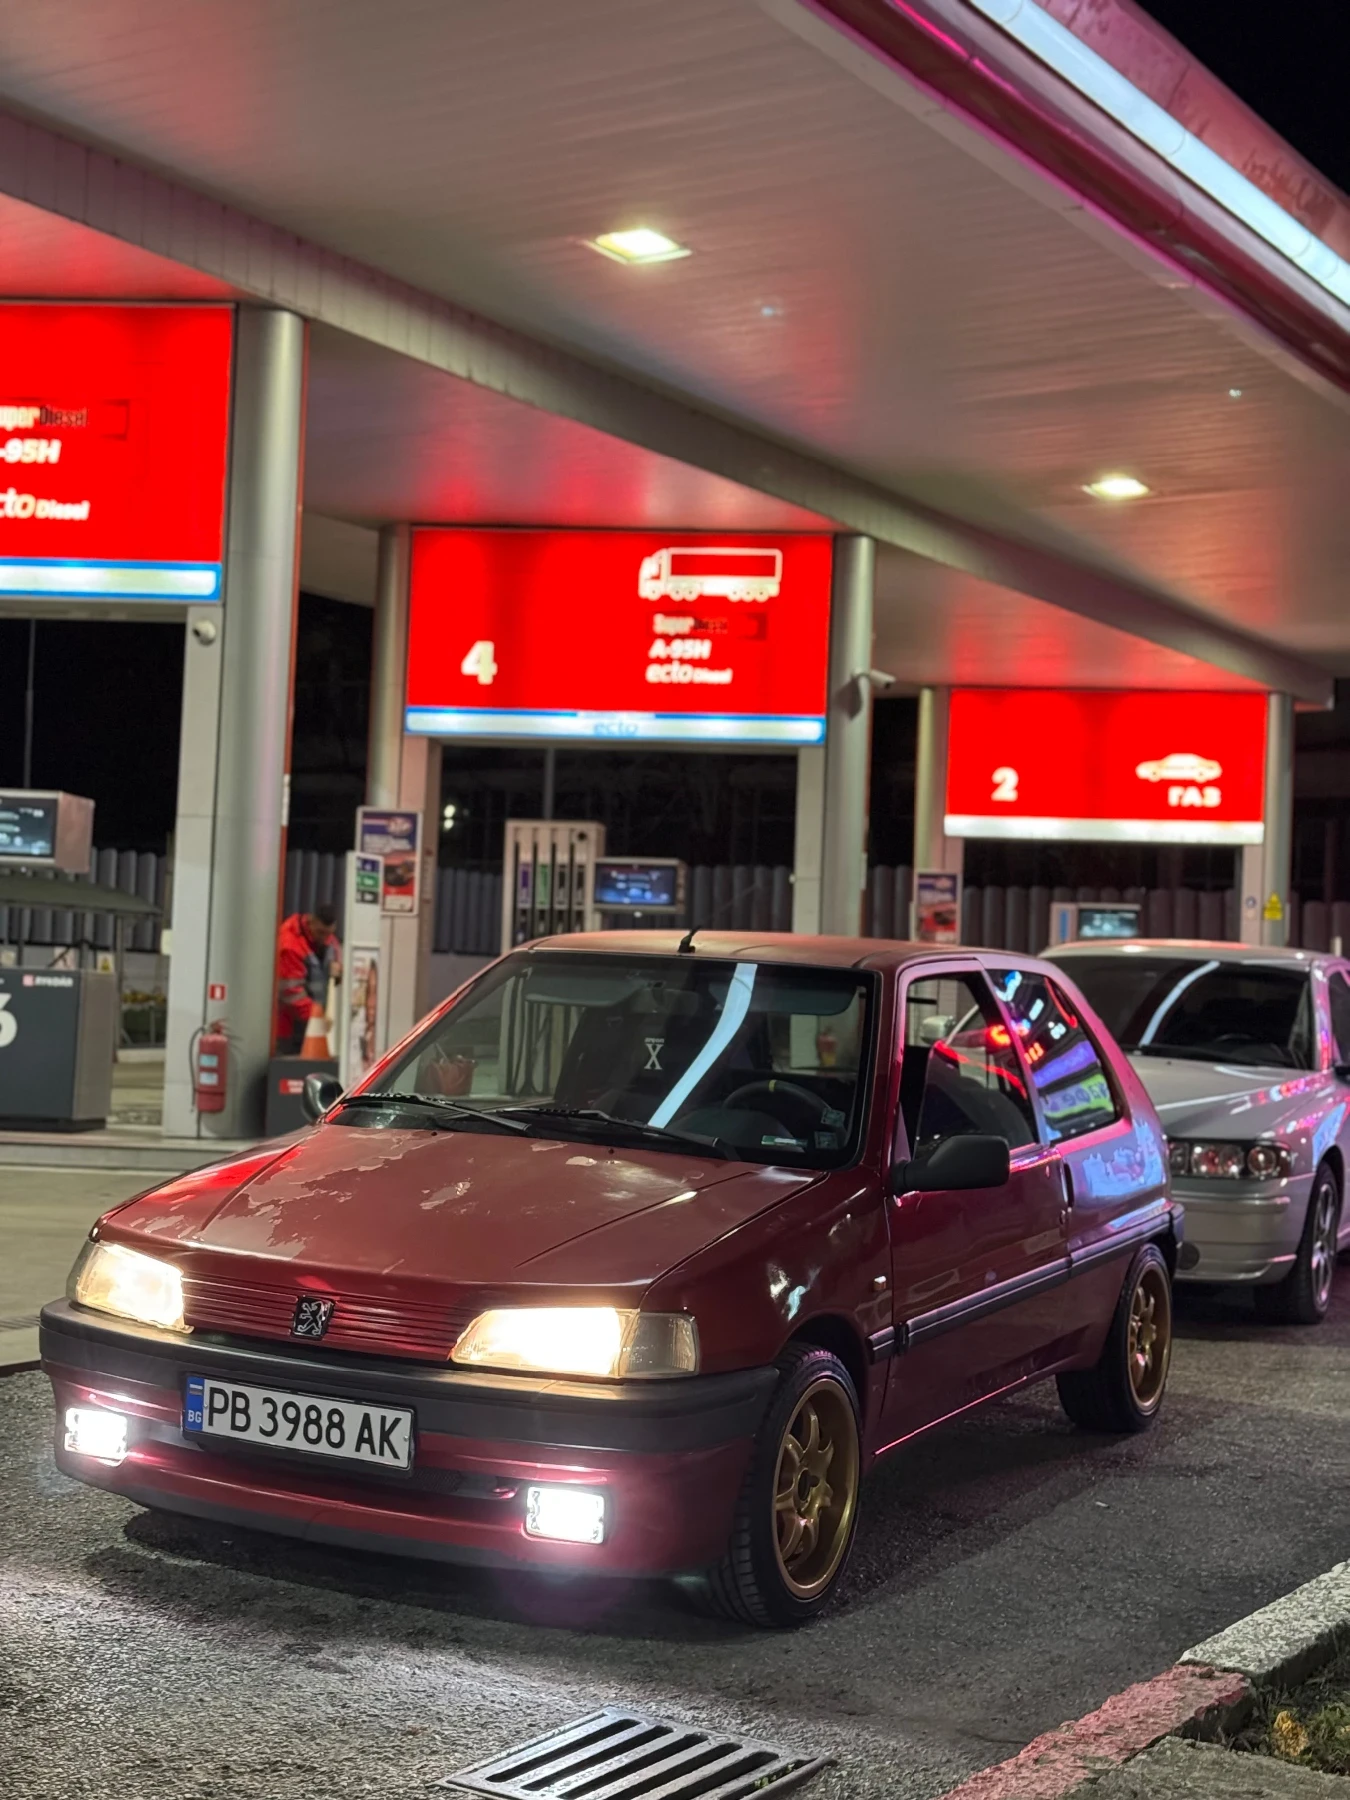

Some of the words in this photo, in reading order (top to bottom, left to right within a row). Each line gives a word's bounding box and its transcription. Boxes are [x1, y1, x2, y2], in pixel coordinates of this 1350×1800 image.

[461, 640, 498, 685] 4
[645, 660, 694, 684] ecto
[991, 766, 1019, 802] 2
[644, 1043, 664, 1070] X
[187, 1409, 202, 1424] BG
[208, 1386, 251, 1433] PB
[258, 1396, 346, 1450] 3988
[354, 1412, 402, 1460] AK
